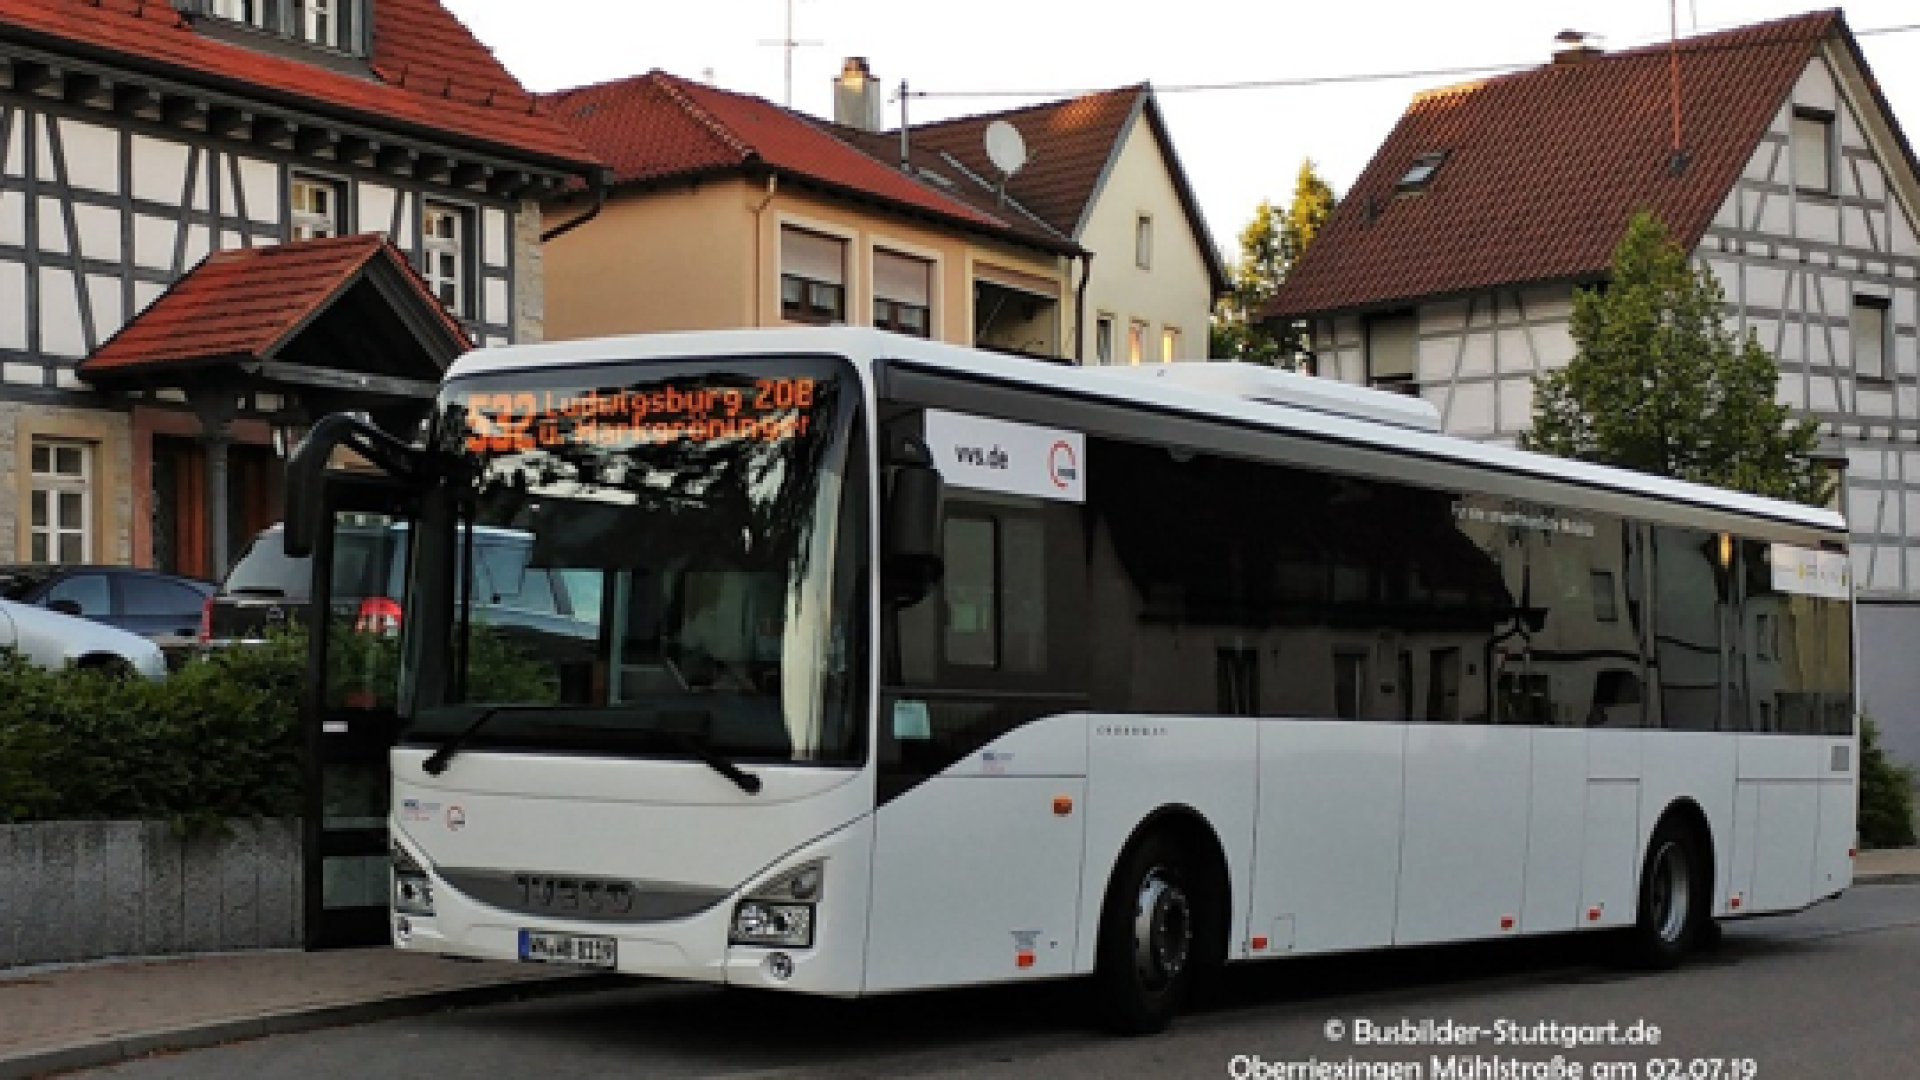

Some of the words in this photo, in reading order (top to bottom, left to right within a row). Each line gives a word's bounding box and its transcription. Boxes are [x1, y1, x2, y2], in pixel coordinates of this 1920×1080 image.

[465, 391, 535, 450] 532
[545, 384, 742, 421] Ludwigsburg
[755, 377, 814, 409] ZOB
[955, 444, 1009, 470] vvs.de
